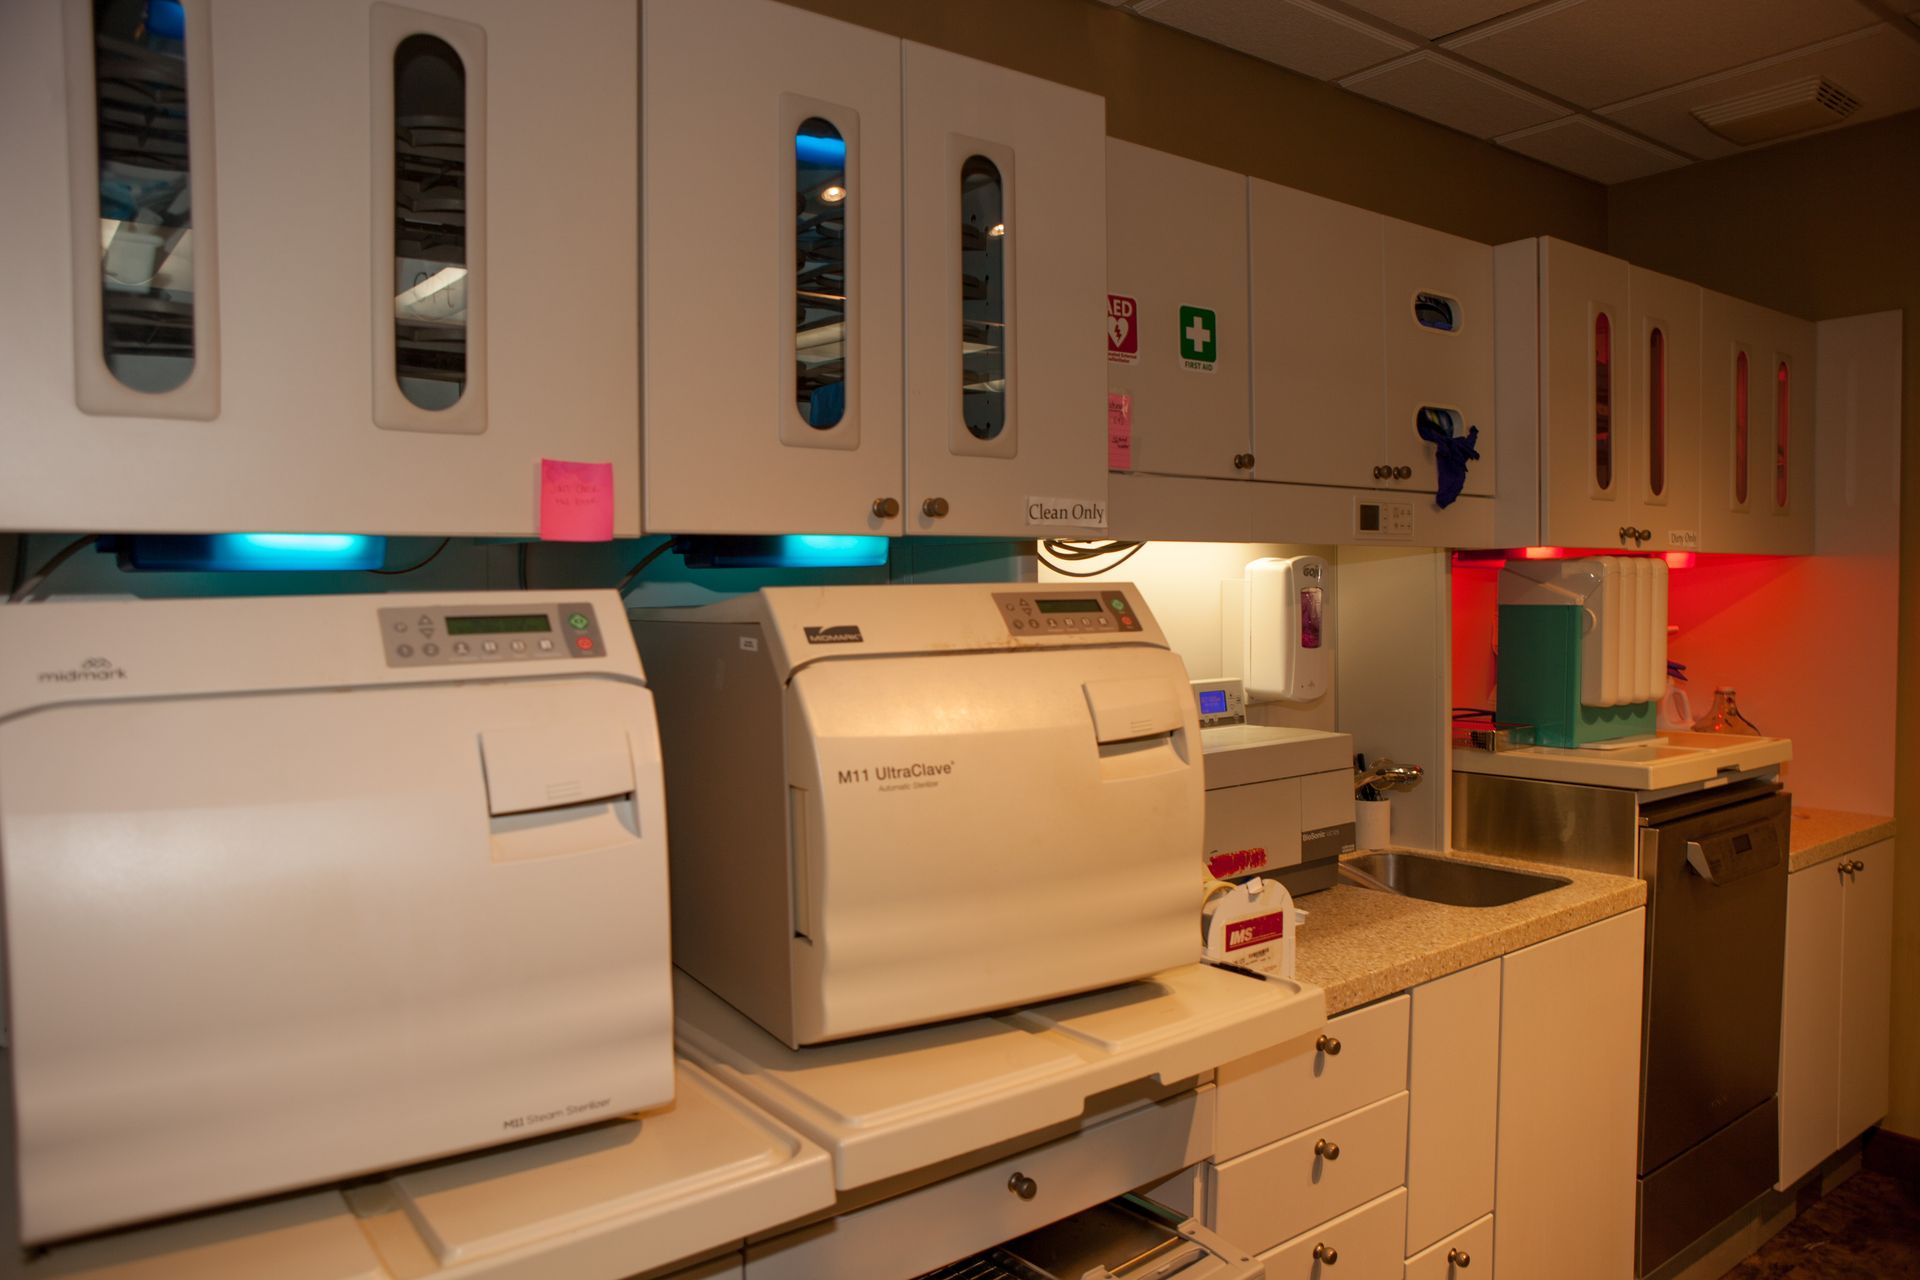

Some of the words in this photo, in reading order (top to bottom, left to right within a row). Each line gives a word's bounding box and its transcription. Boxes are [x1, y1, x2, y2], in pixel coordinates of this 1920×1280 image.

[1184, 360, 1201, 369] FIRST
[1202, 362, 1213, 371] AID
[1029, 503, 1068, 520] Clean
[1072, 503, 1104, 524] Only
[37, 667, 128, 683] midmark
[838, 769, 869, 784] M11
[503, 1117, 524, 1129] M11
[525, 1110, 564, 1126] Steam
[565, 1097, 611, 1116] Sterilizer
